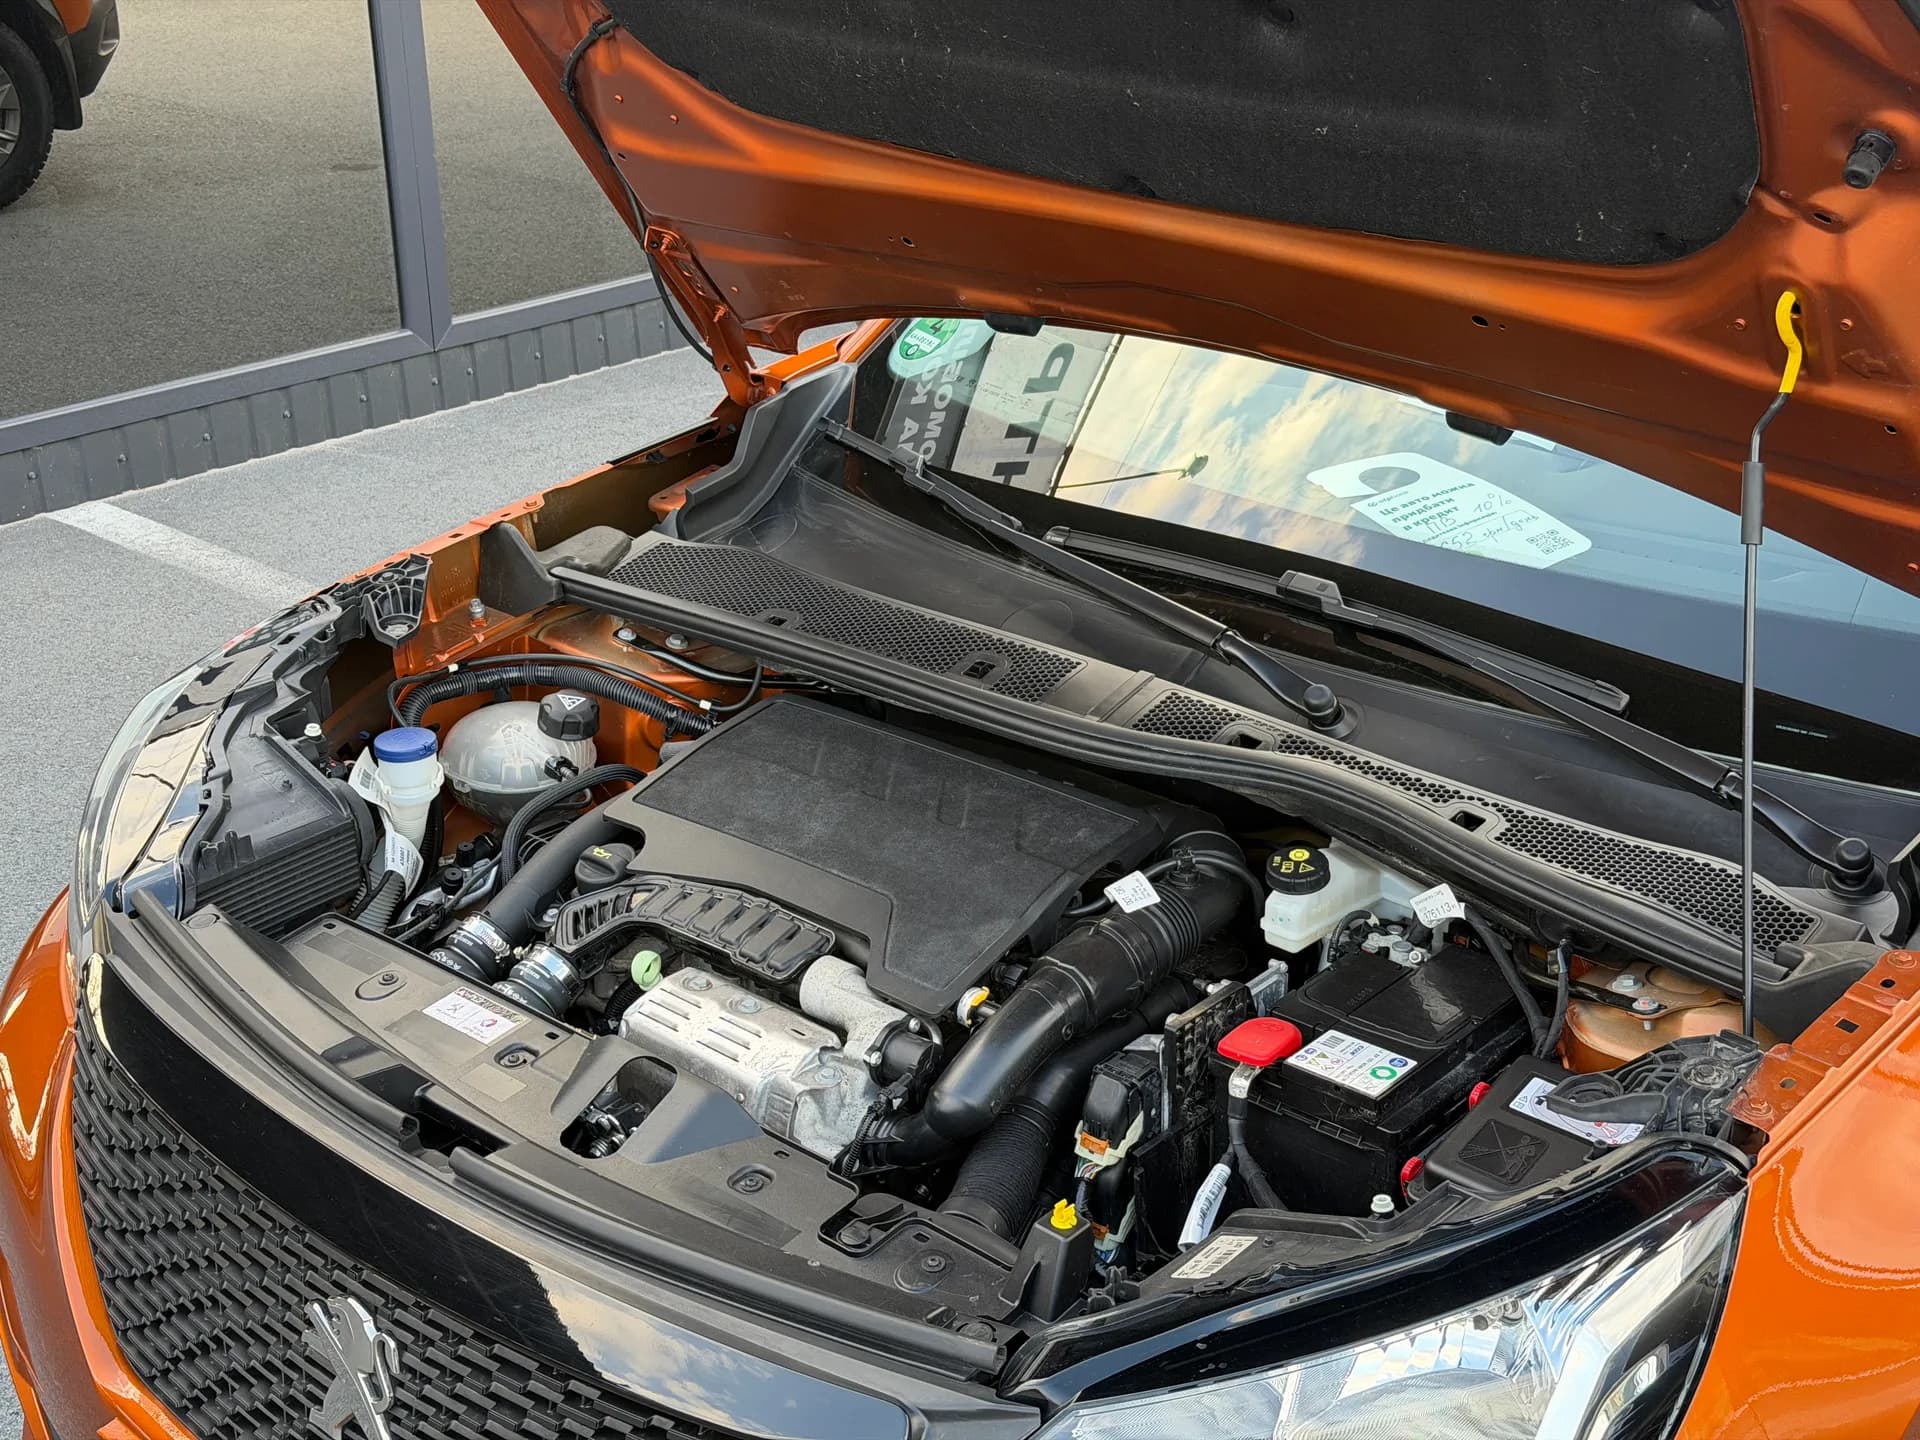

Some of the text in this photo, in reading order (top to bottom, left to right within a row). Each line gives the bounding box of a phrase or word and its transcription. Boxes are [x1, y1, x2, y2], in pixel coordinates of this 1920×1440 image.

[1400, 495, 1430, 509] авто
[1431, 482, 1475, 498] можна
[1391, 497, 1455, 524] придбати
